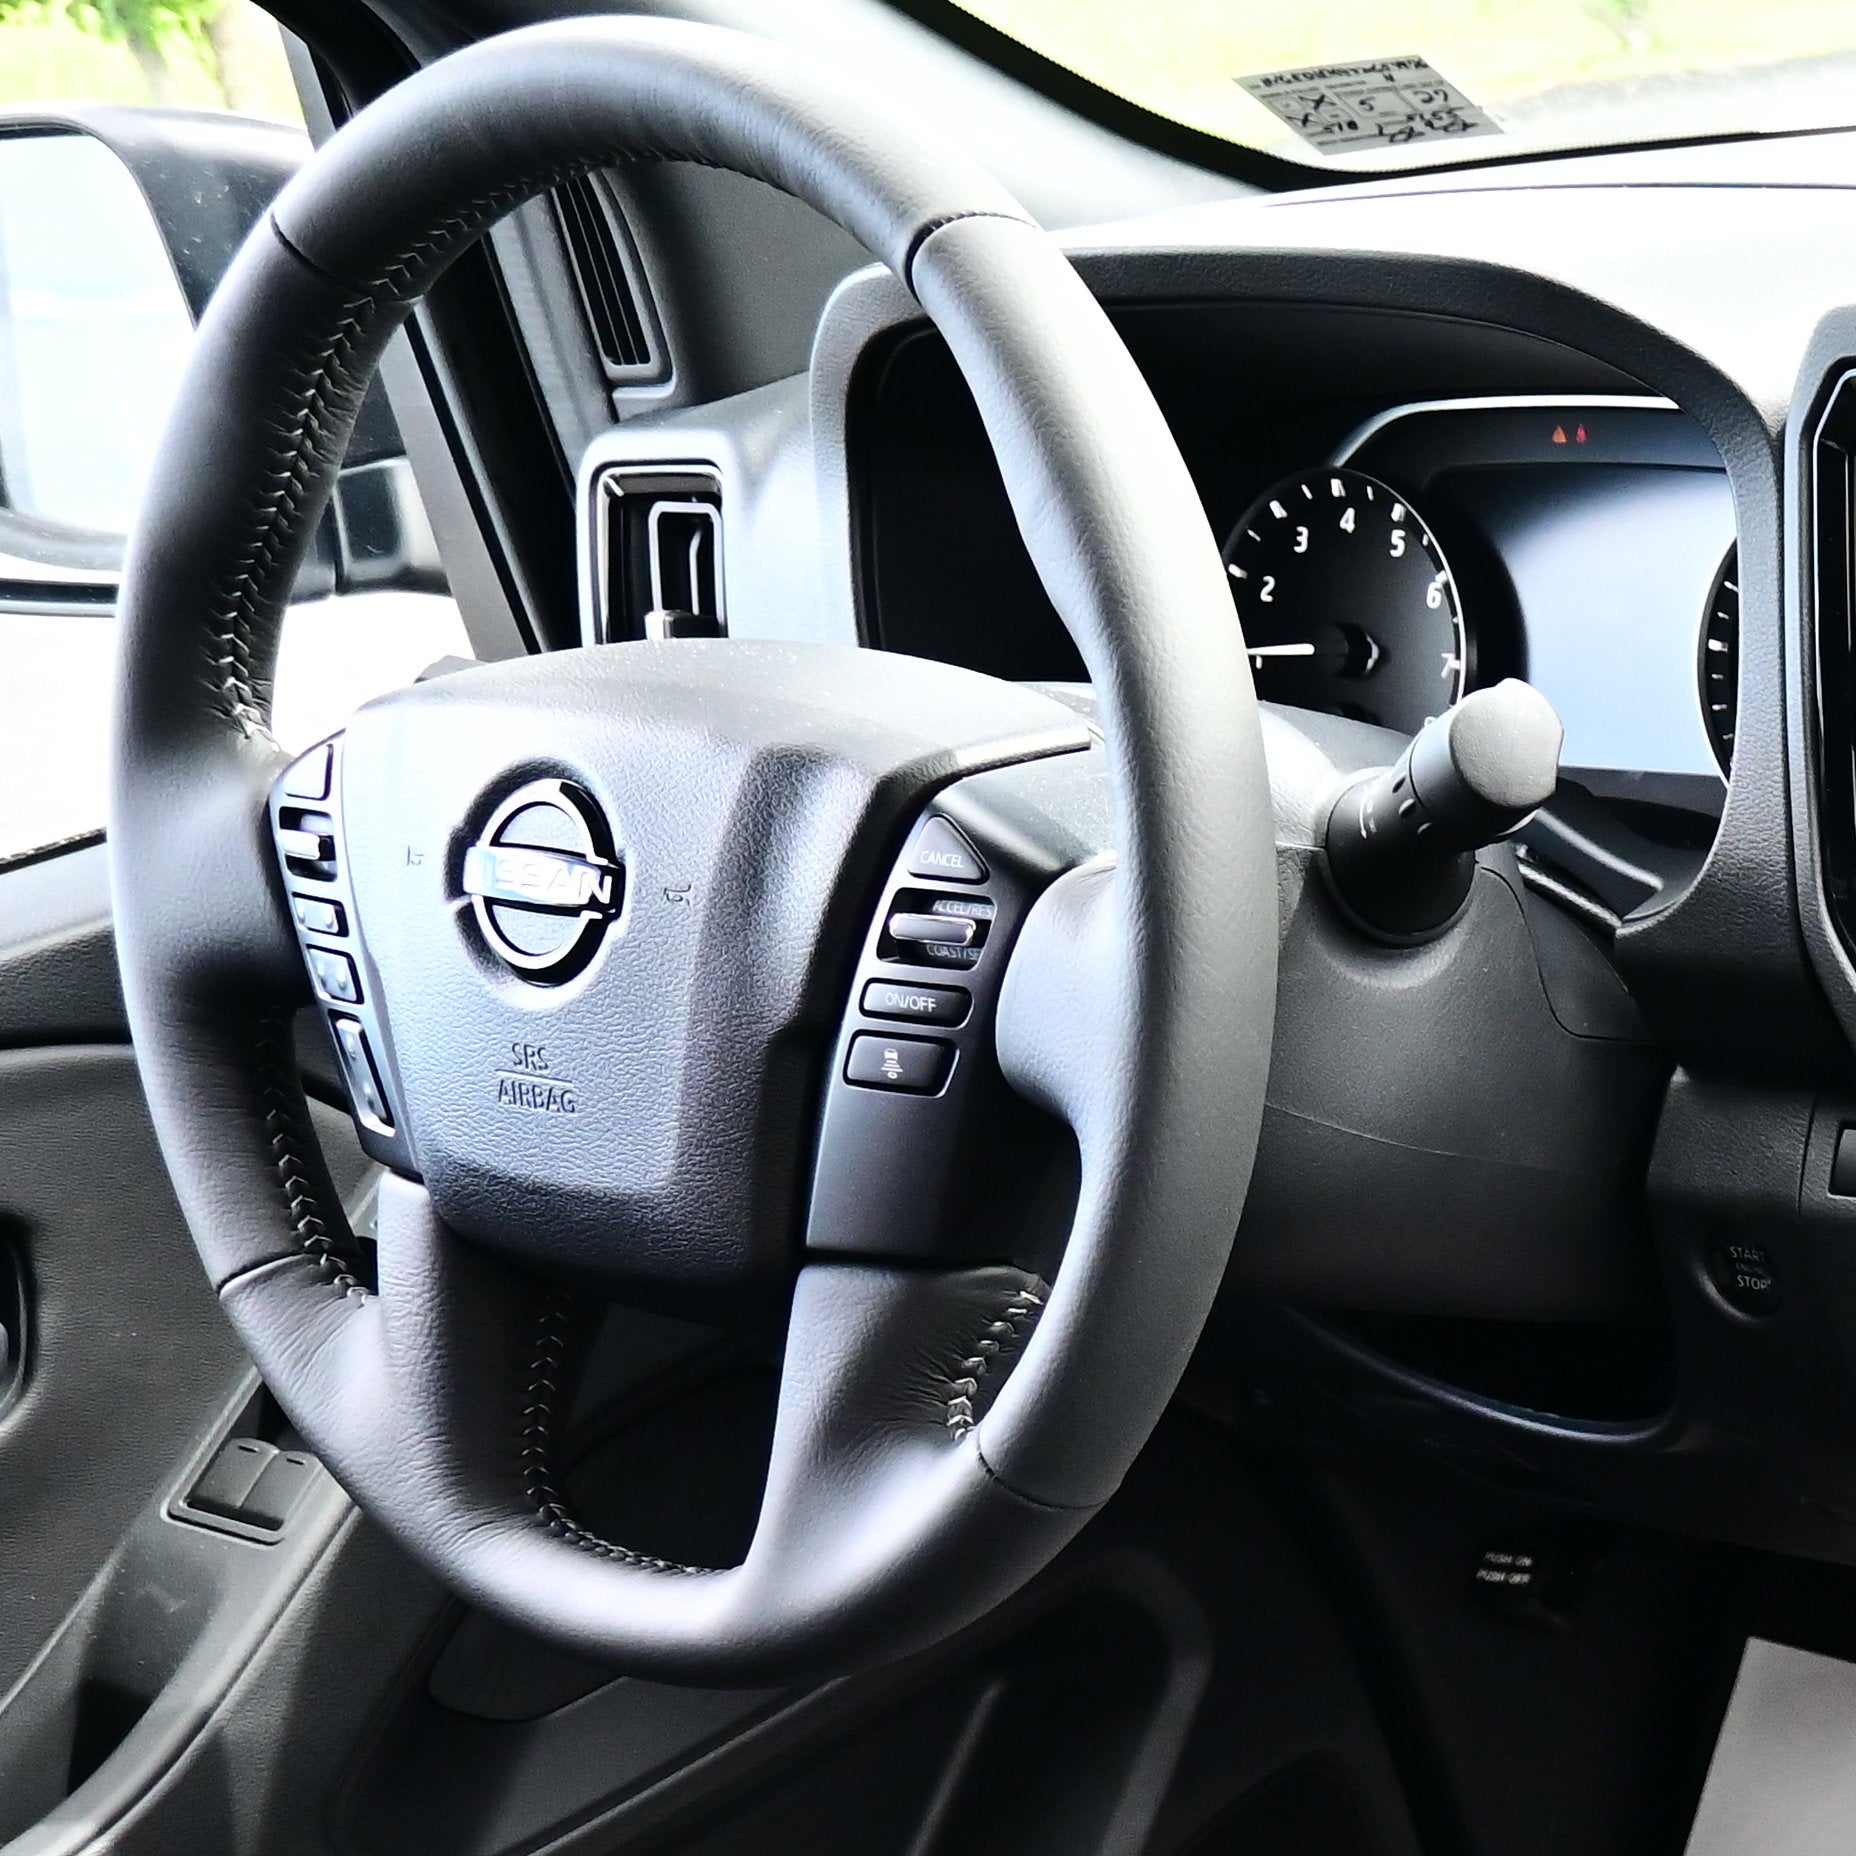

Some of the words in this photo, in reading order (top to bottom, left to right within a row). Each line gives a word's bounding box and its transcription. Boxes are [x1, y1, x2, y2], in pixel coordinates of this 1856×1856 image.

[1339, 506, 1356, 534] 4
[1293, 525, 1309, 554] 3
[1389, 528, 1406, 558] 5
[1259, 575, 1276, 603] 2
[1425, 580, 1443, 610] 6
[919, 849, 965, 869] CANCEL
[885, 991, 938, 1013] ON/OFF
[511, 1042, 549, 1071] SRS
[497, 1079, 576, 1114] AIRBAG
[1729, 1246, 1766, 1263] START
[1736, 1274, 1768, 1291] STOP
